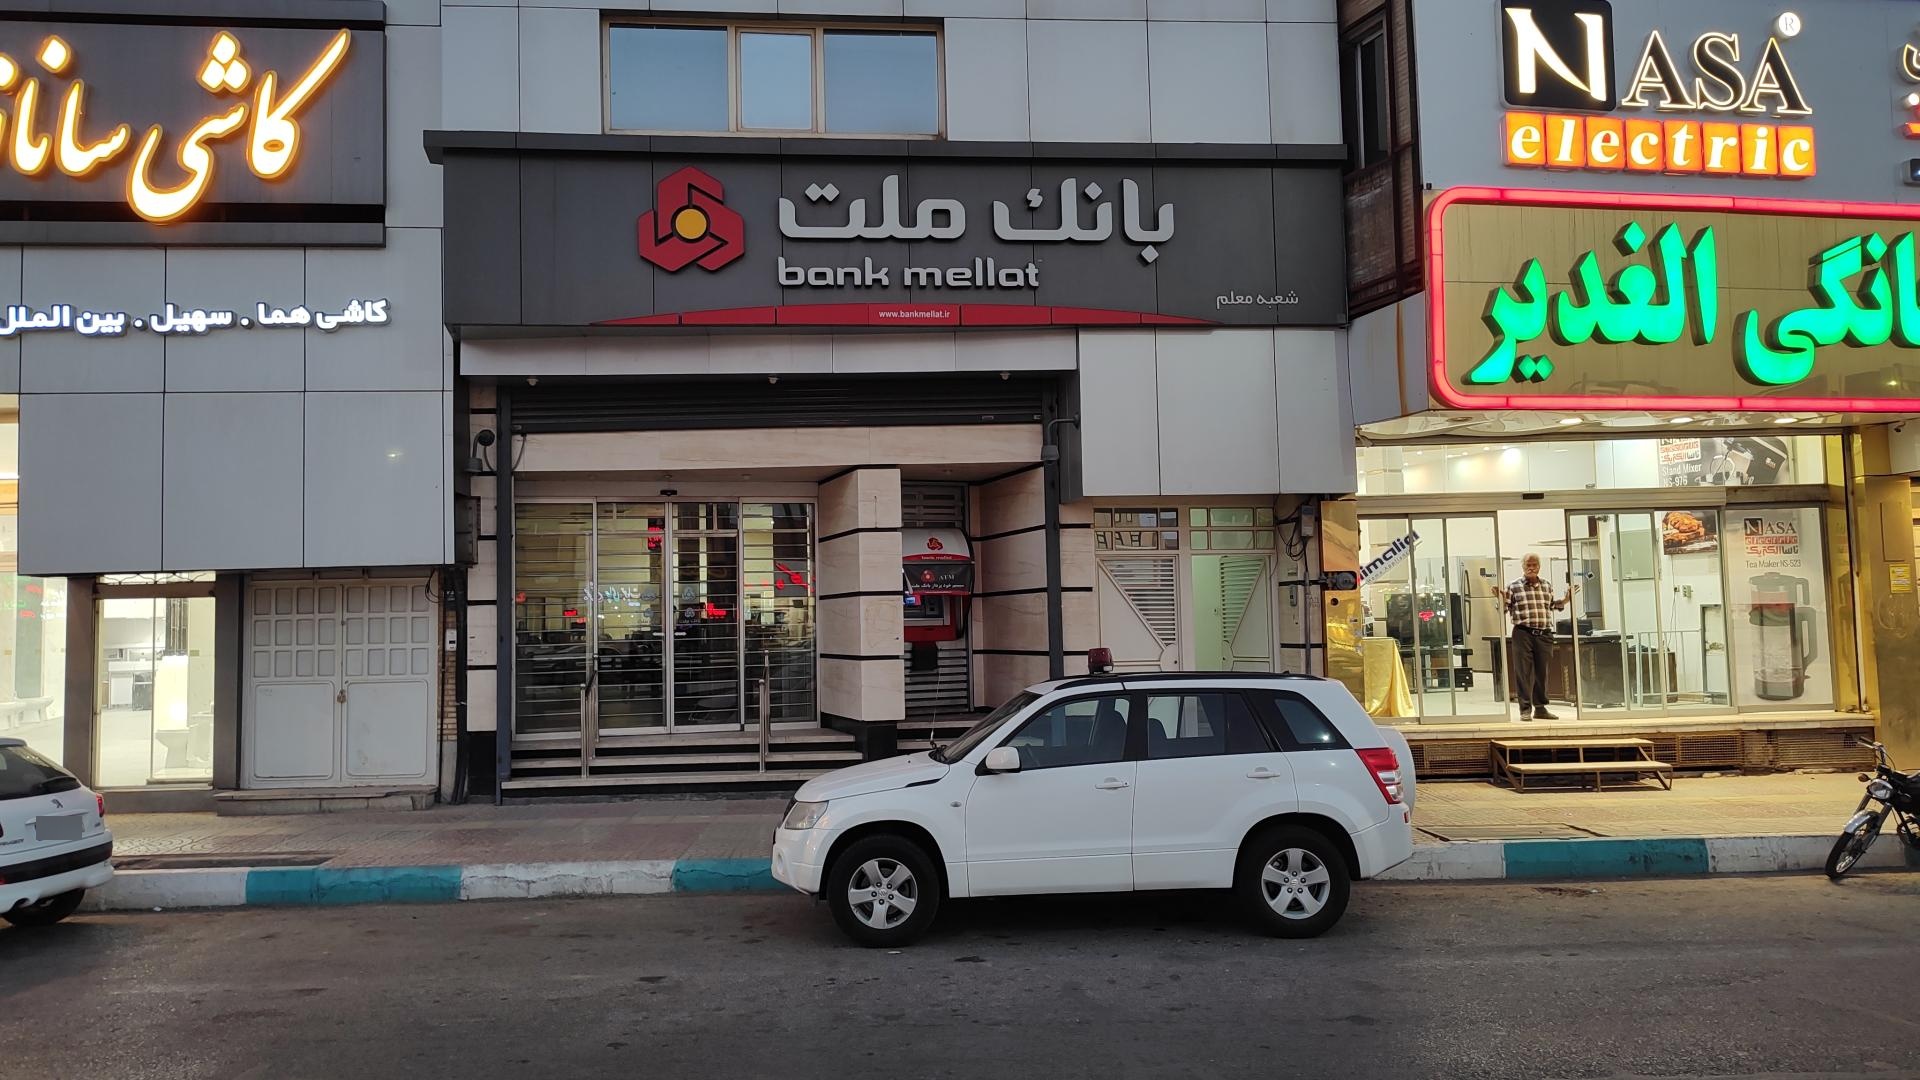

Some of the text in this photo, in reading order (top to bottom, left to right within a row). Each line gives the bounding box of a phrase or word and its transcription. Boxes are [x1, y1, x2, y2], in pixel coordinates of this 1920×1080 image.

[1505, 8, 1812, 115] NASA
[0, 28, 351, 223] کاشی سانا
[1509, 117, 1811, 173] electric
[779, 174, 966, 239] ملت
[778, 256, 1039, 288] bank mellat
[256, 302, 312, 326] هما
[316, 299, 389, 330] کاشی
[878, 310, 951, 319] www.bankmellat.ir
[1216, 290, 1299, 310] شعبه معلم
[1467, 221, 1920, 385] انگی الغدیر
[75, 311, 127, 335] بین
[149, 302, 234, 333] سهیل
[1683, 462, 1702, 474] Mixer
[1744, 518, 1797, 536] NASA
[1758, 560, 1779, 569] Maker
